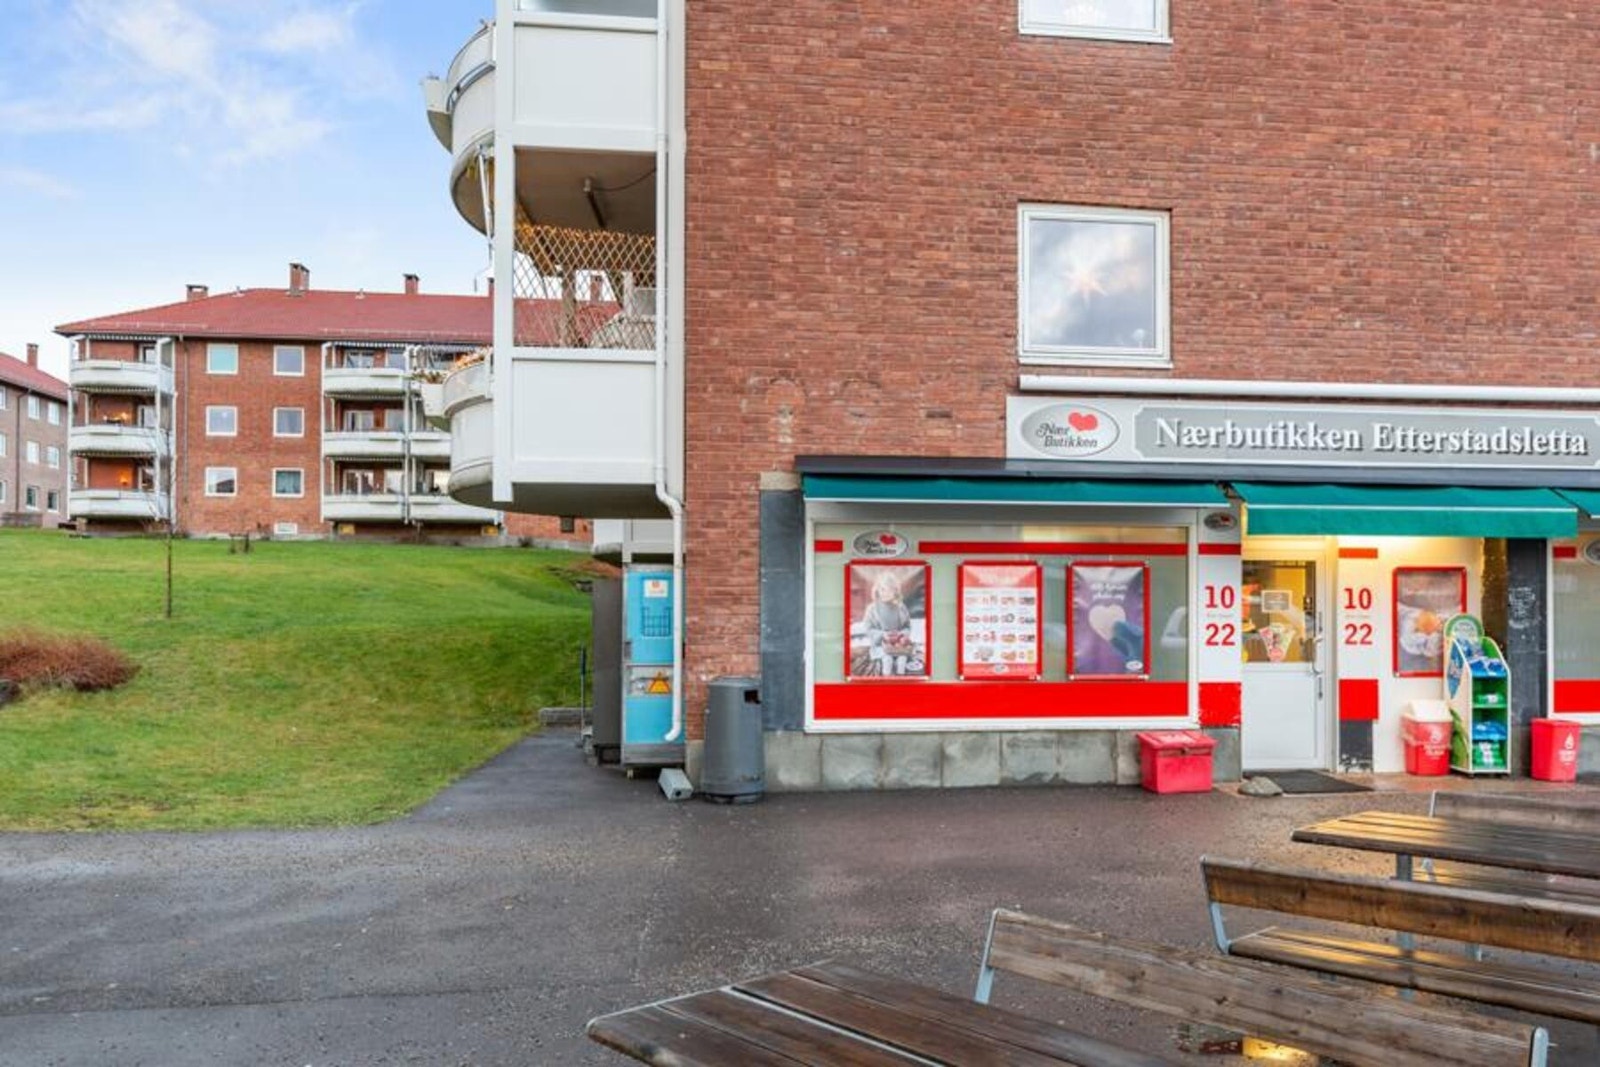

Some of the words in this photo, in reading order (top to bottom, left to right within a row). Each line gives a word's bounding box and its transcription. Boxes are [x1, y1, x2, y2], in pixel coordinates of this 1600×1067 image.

[1036, 422, 1070, 438] Nær
[1156, 417, 1363, 451] Nærbutikken
[1372, 423, 1588, 455] Etterstadsletta
[1045, 436, 1097, 448] Butikken
[1205, 585, 1235, 609] 10
[1344, 587, 1372, 610] 10
[1205, 622, 1236, 647] 22
[1344, 623, 1373, 645] 22
